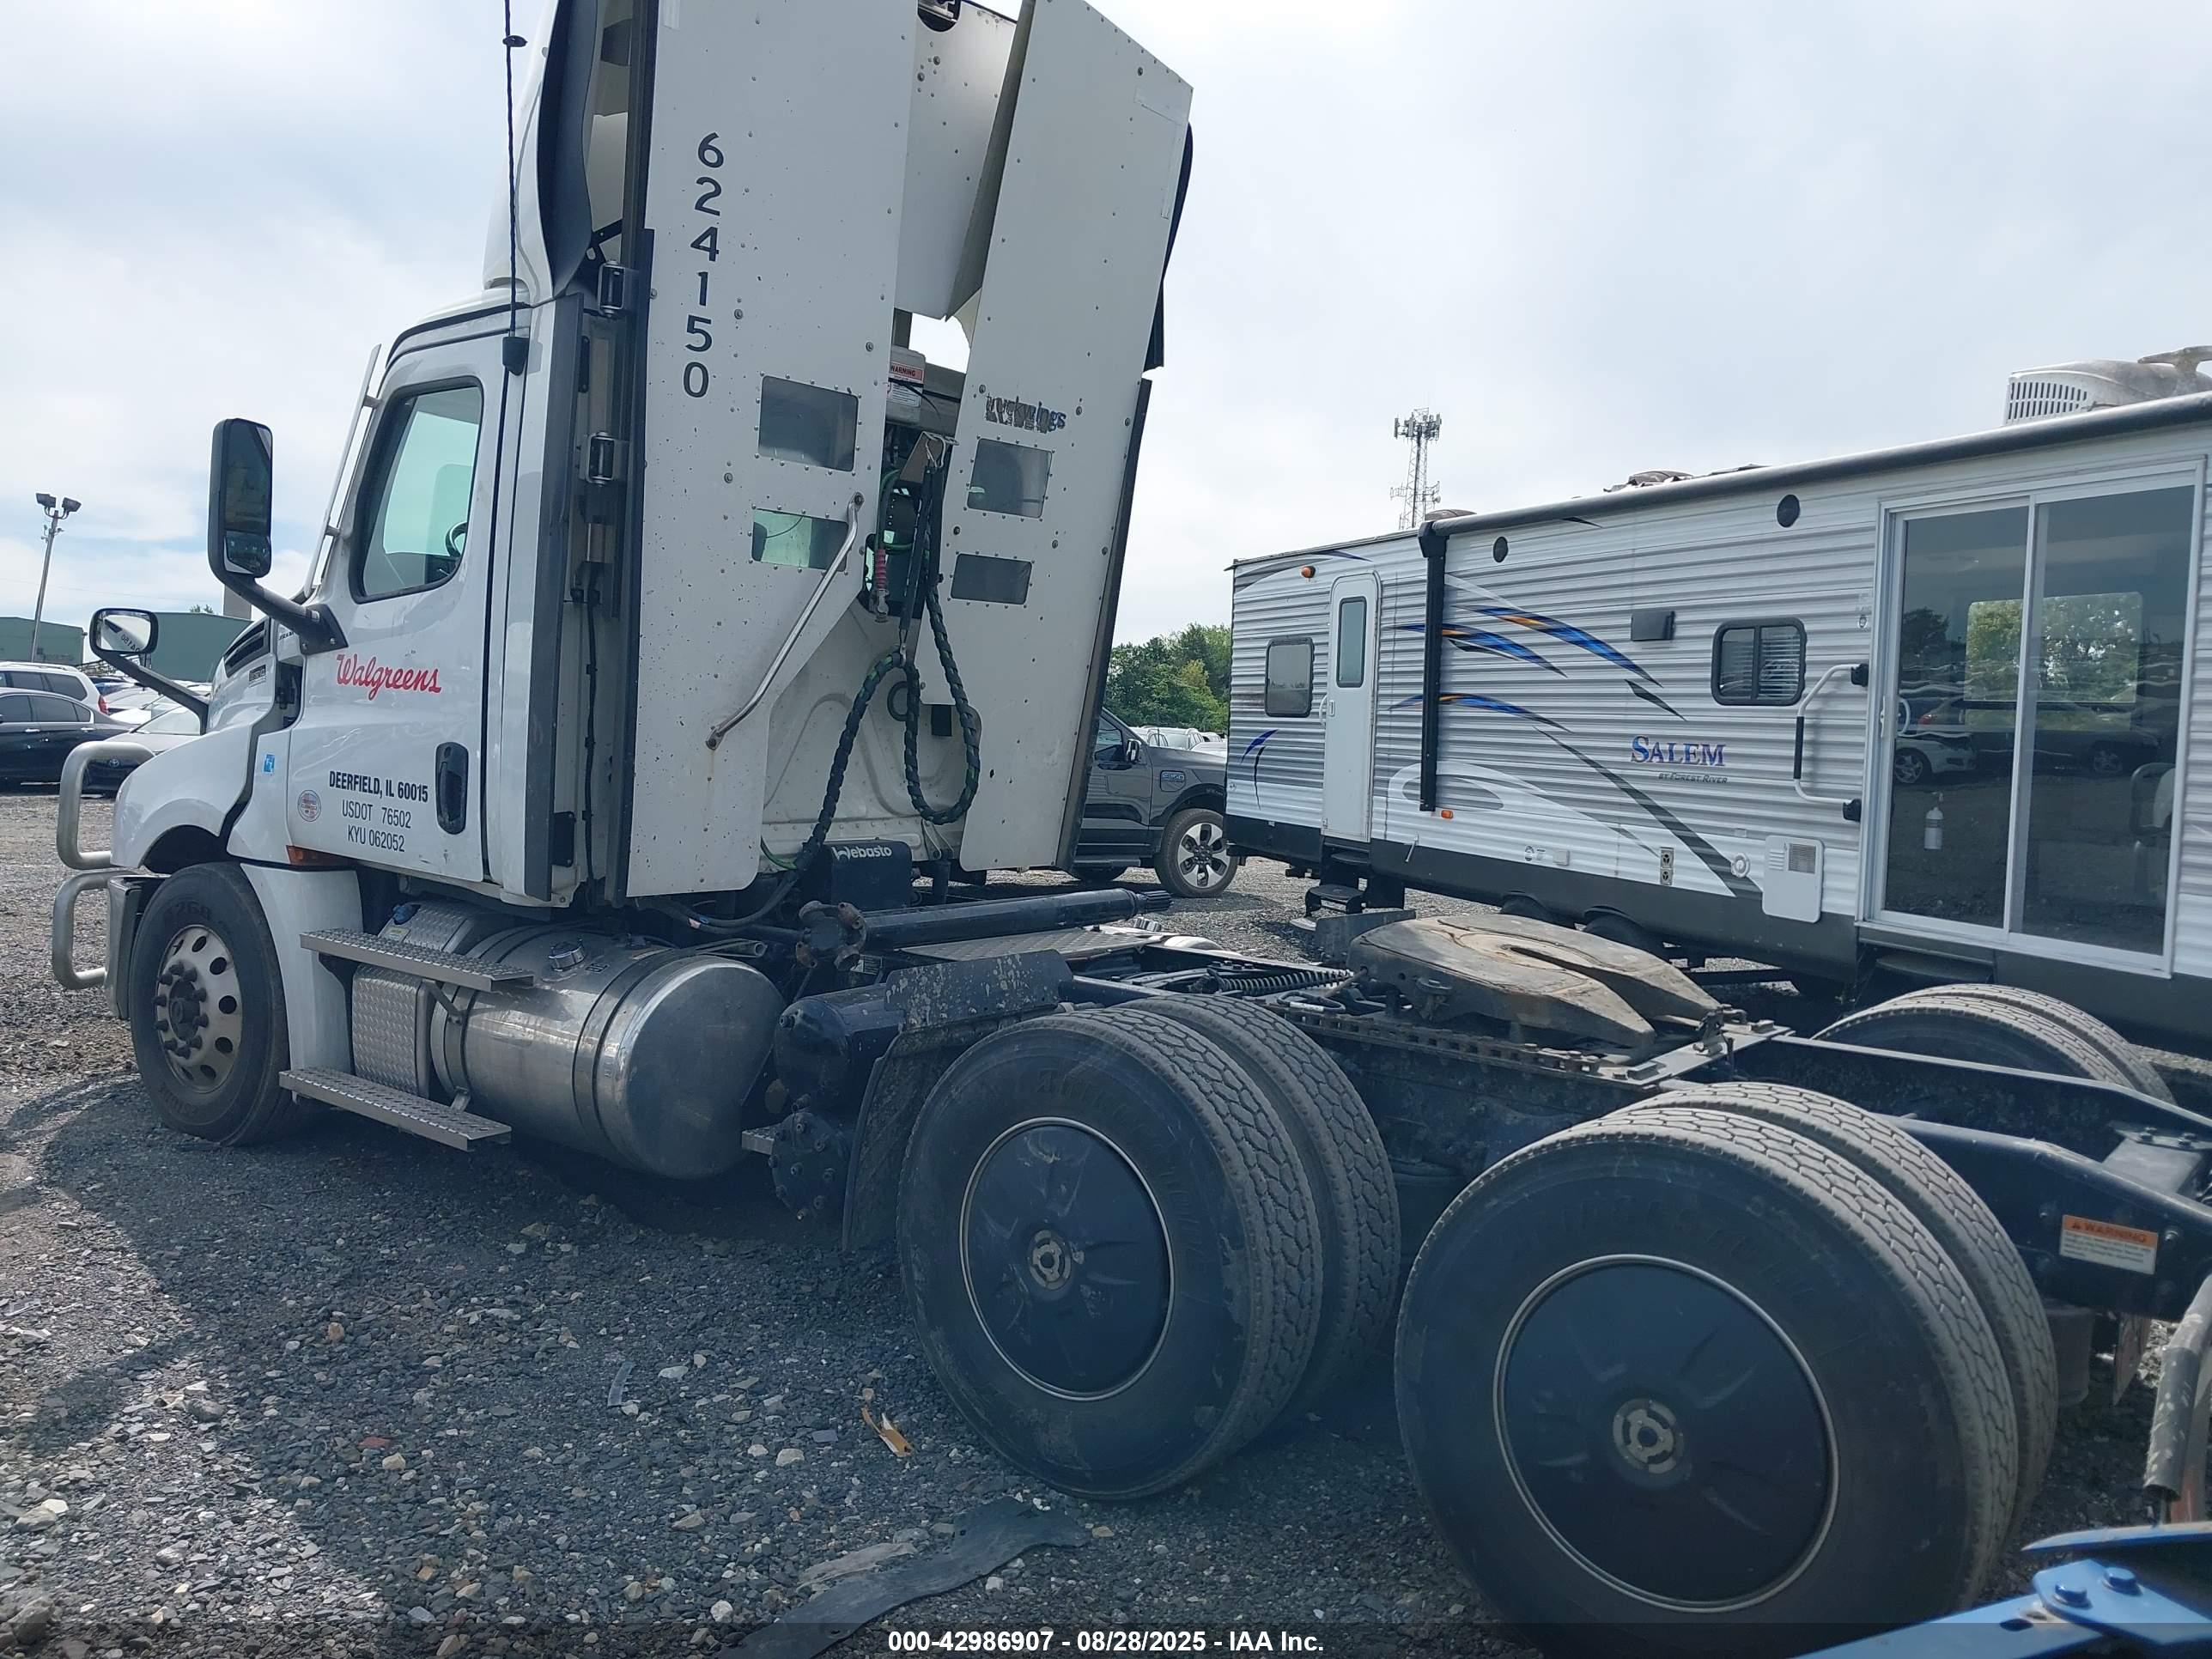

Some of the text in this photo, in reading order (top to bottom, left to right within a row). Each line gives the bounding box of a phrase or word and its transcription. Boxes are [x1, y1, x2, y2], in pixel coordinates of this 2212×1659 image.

[683, 132, 725, 398] 624150
[336, 653, 442, 701] Walgreens
[329, 770, 428, 803] DEERFIELD, IL 60015
[342, 799, 374, 822] USDOT
[381, 807, 411, 829] 76502
[348, 824, 405, 853] KYU 062052
[830, 845, 892, 861] Webasto
